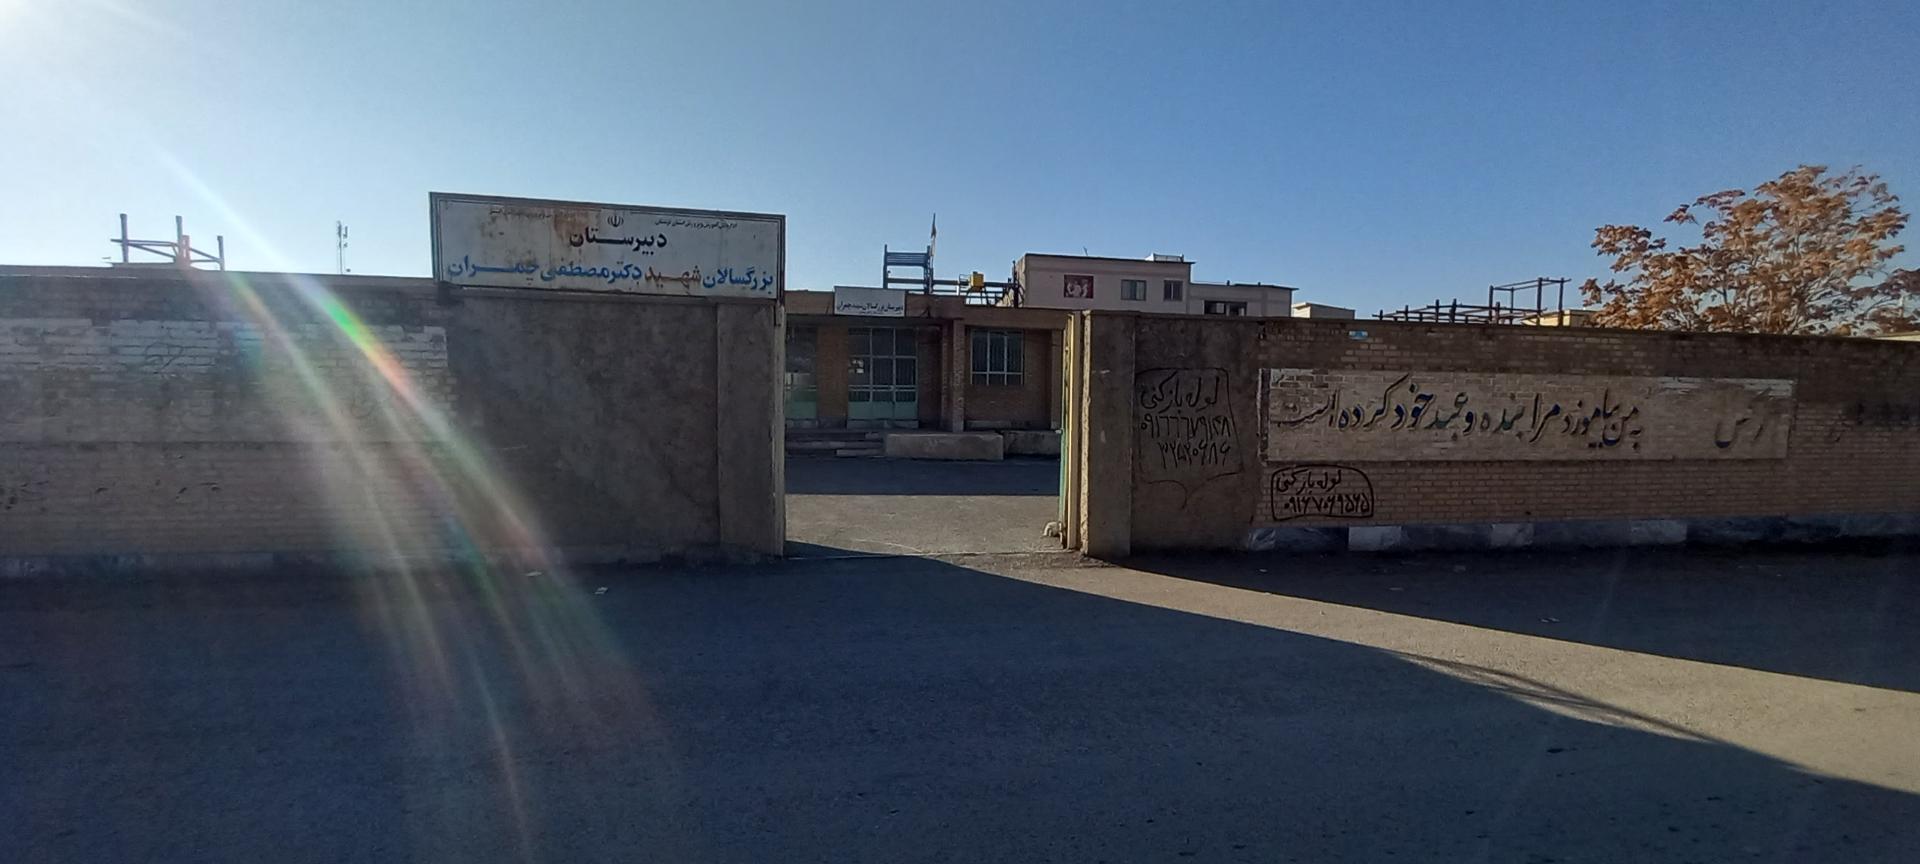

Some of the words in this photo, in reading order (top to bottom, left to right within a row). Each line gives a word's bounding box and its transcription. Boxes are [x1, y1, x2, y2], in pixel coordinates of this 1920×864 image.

[569, 226, 668, 256] دبیرستان
[447, 254, 540, 286] چمران
[541, 257, 609, 282] مصطفی
[608, 261, 642, 283] دکتر
[644, 264, 700, 290] شهید
[702, 265, 774, 295] بزرگسالان
[1186, 376, 1220, 413] لوله
[1338, 373, 1410, 431] کرده
[1391, 381, 1435, 431] خود
[1425, 391, 1469, 441] عبد
[1463, 410, 1475, 436] و
[1479, 392, 1526, 440] بنده
[1529, 393, 1561, 443] مرا
[1316, 469, 1342, 492] لوله
